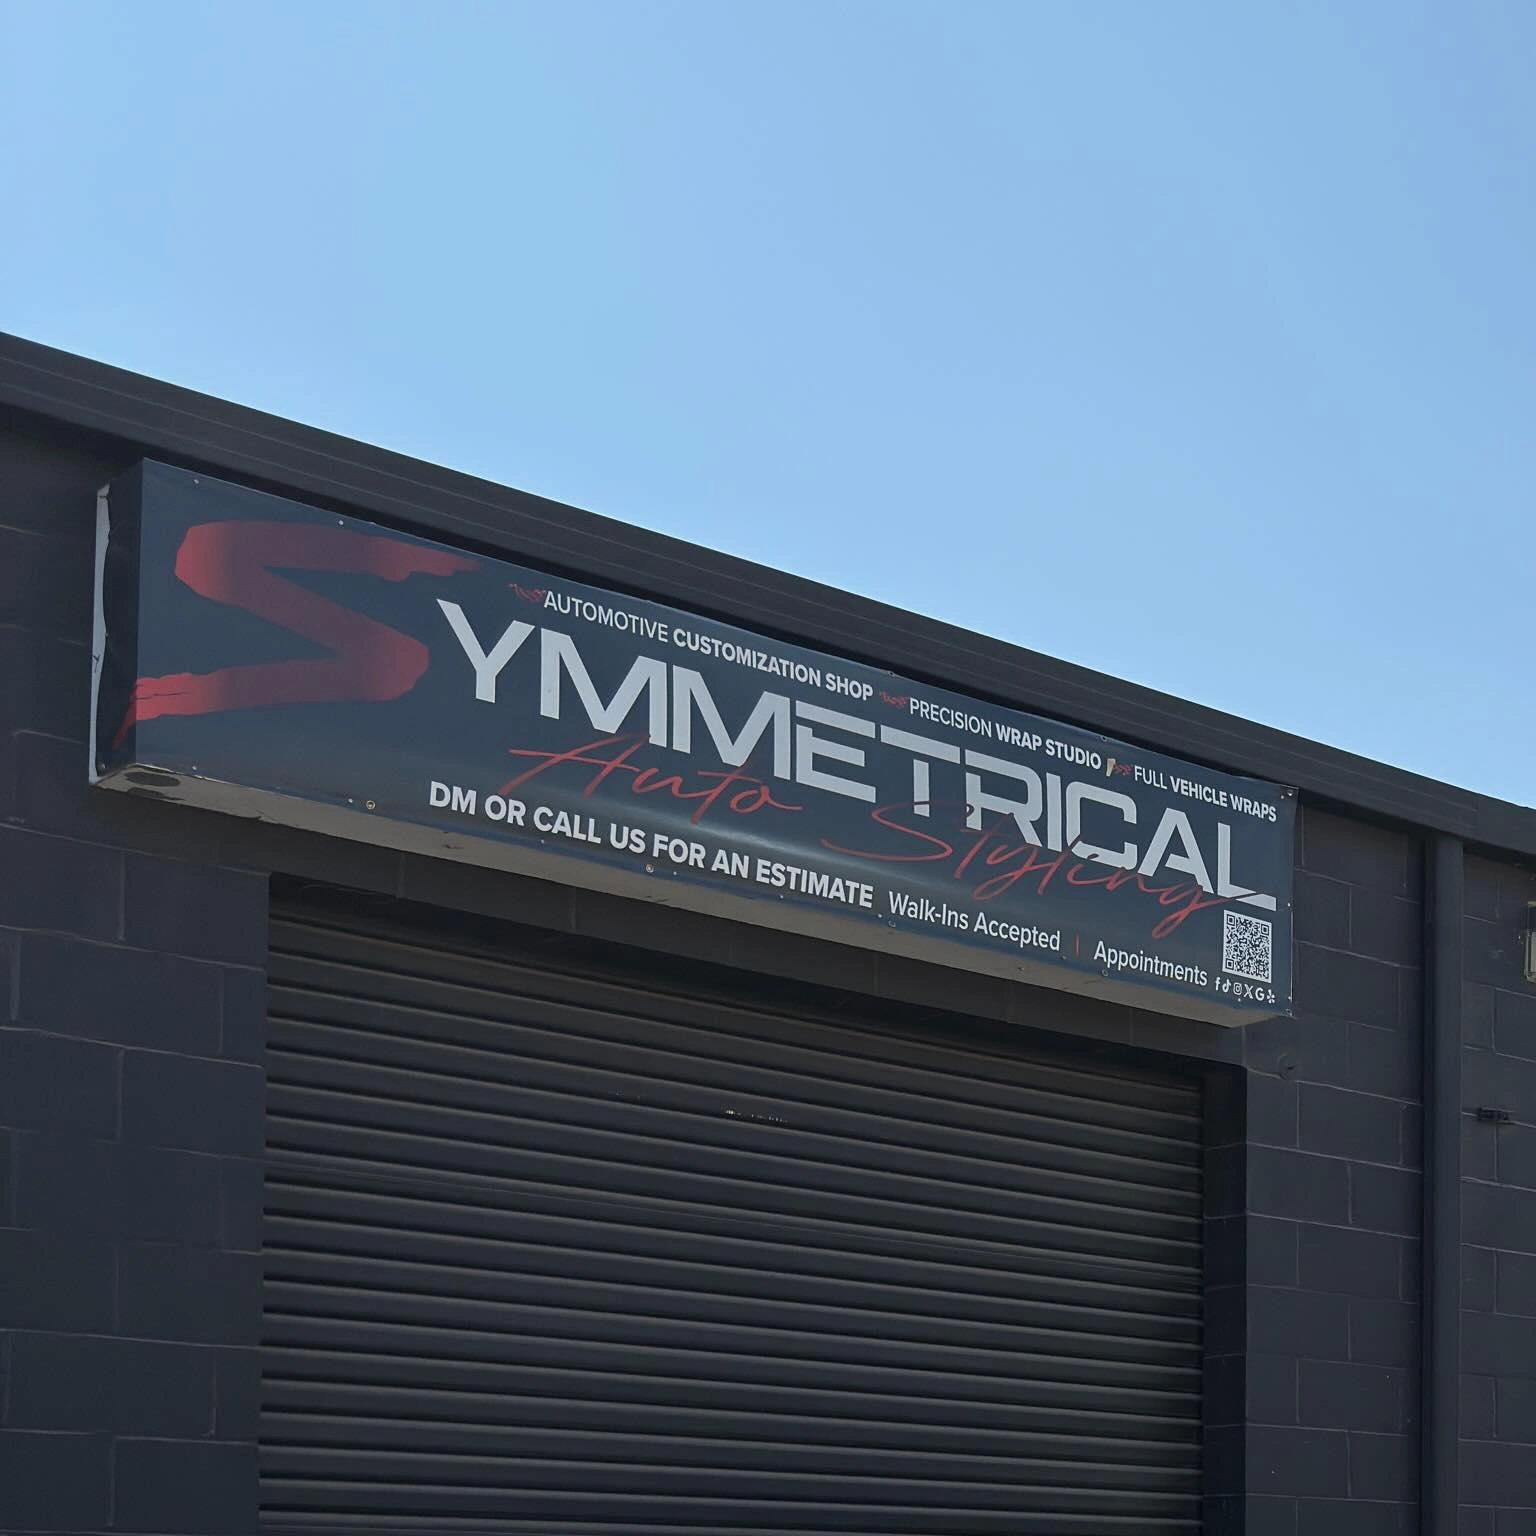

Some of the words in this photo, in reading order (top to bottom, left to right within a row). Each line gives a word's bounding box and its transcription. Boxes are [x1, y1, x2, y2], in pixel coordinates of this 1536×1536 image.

[544, 590, 669, 643] AUTOMOTIVE
[673, 627, 822, 687] CUSTOMIZATION
[825, 672, 874, 701] SHOP
[909, 697, 993, 738] PRECISION
[995, 723, 1043, 752] WRAP
[1045, 739, 1102, 770] STUDIO
[1134, 765, 1168, 790] FULL
[1170, 775, 1228, 808] VEHICLE
[1230, 795, 1278, 823] WRAPS
[498, 733, 803, 825] Auto
[429, 780, 477, 816] DM
[484, 794, 525, 826] OR
[533, 806, 602, 844] CALL
[609, 822, 646, 855] US
[652, 833, 706, 869] FOR
[711, 848, 750, 878] AN
[755, 858, 874, 908] ESTIMATE
[889, 890, 969, 931] Walk-Ins
[974, 911, 1061, 952] Accepted
[1094, 940, 1208, 987] Appointments
